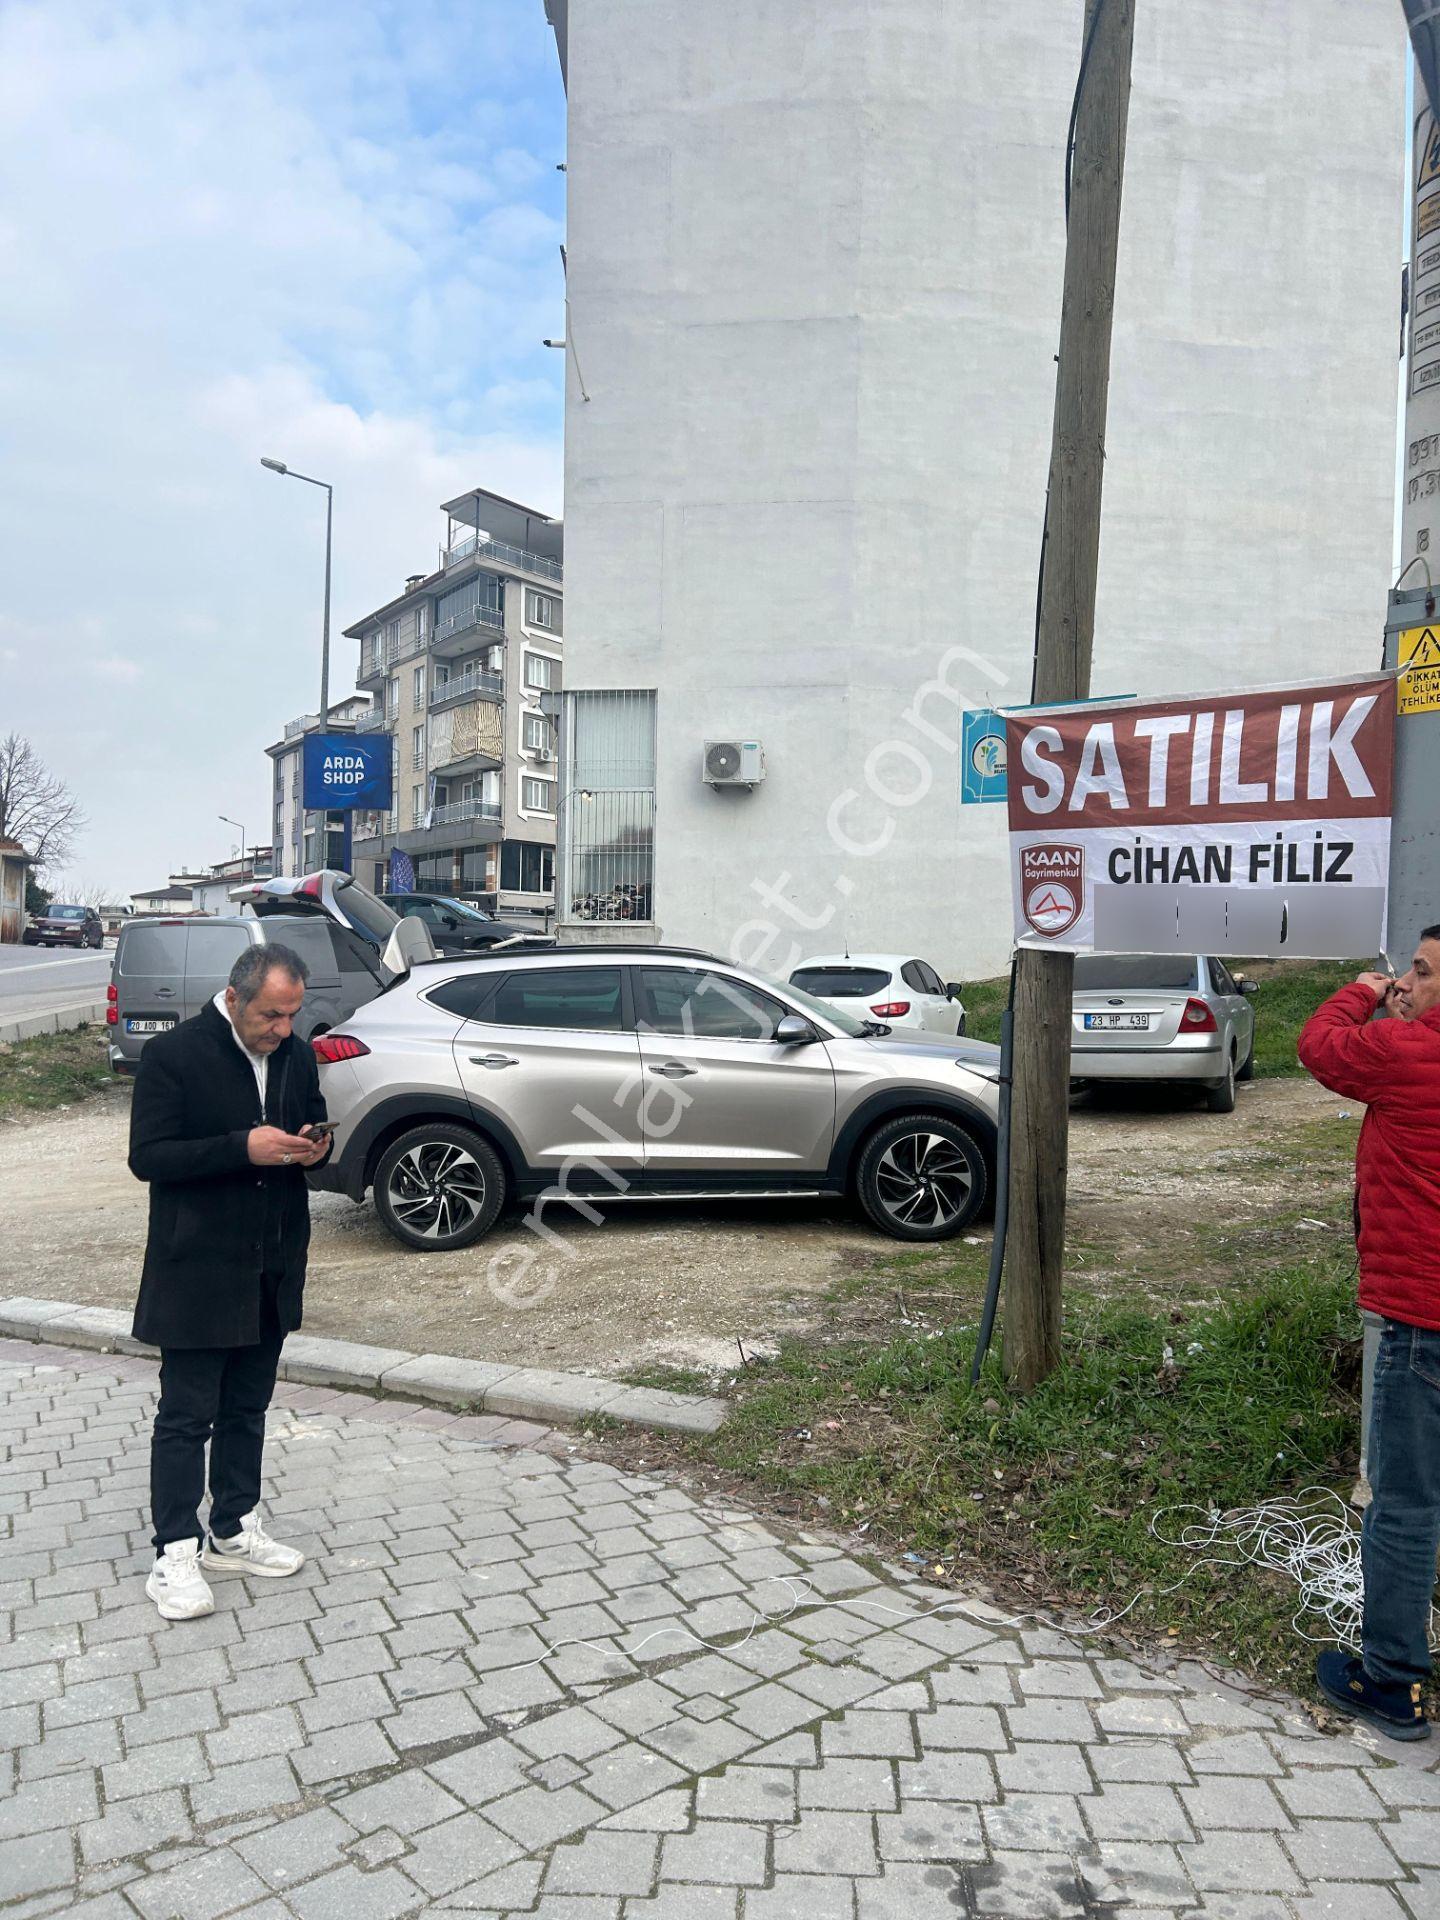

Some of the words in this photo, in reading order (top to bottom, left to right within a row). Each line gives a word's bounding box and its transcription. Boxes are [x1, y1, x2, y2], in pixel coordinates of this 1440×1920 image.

[1021, 695, 1377, 815] SATILIK
[323, 756, 365, 769] ARDA
[323, 772, 365, 784] SHOP
[1025, 851, 1080, 866] KAAN
[1108, 836, 1232, 884] CİHAN
[1248, 831, 1354, 882] FİLİZ
[1025, 868, 1079, 879] Gayrimenkul
[1092, 1015, 1103, 1026] 23
[1109, 1015, 1121, 1025] HP
[1129, 1015, 1147, 1025] 439
